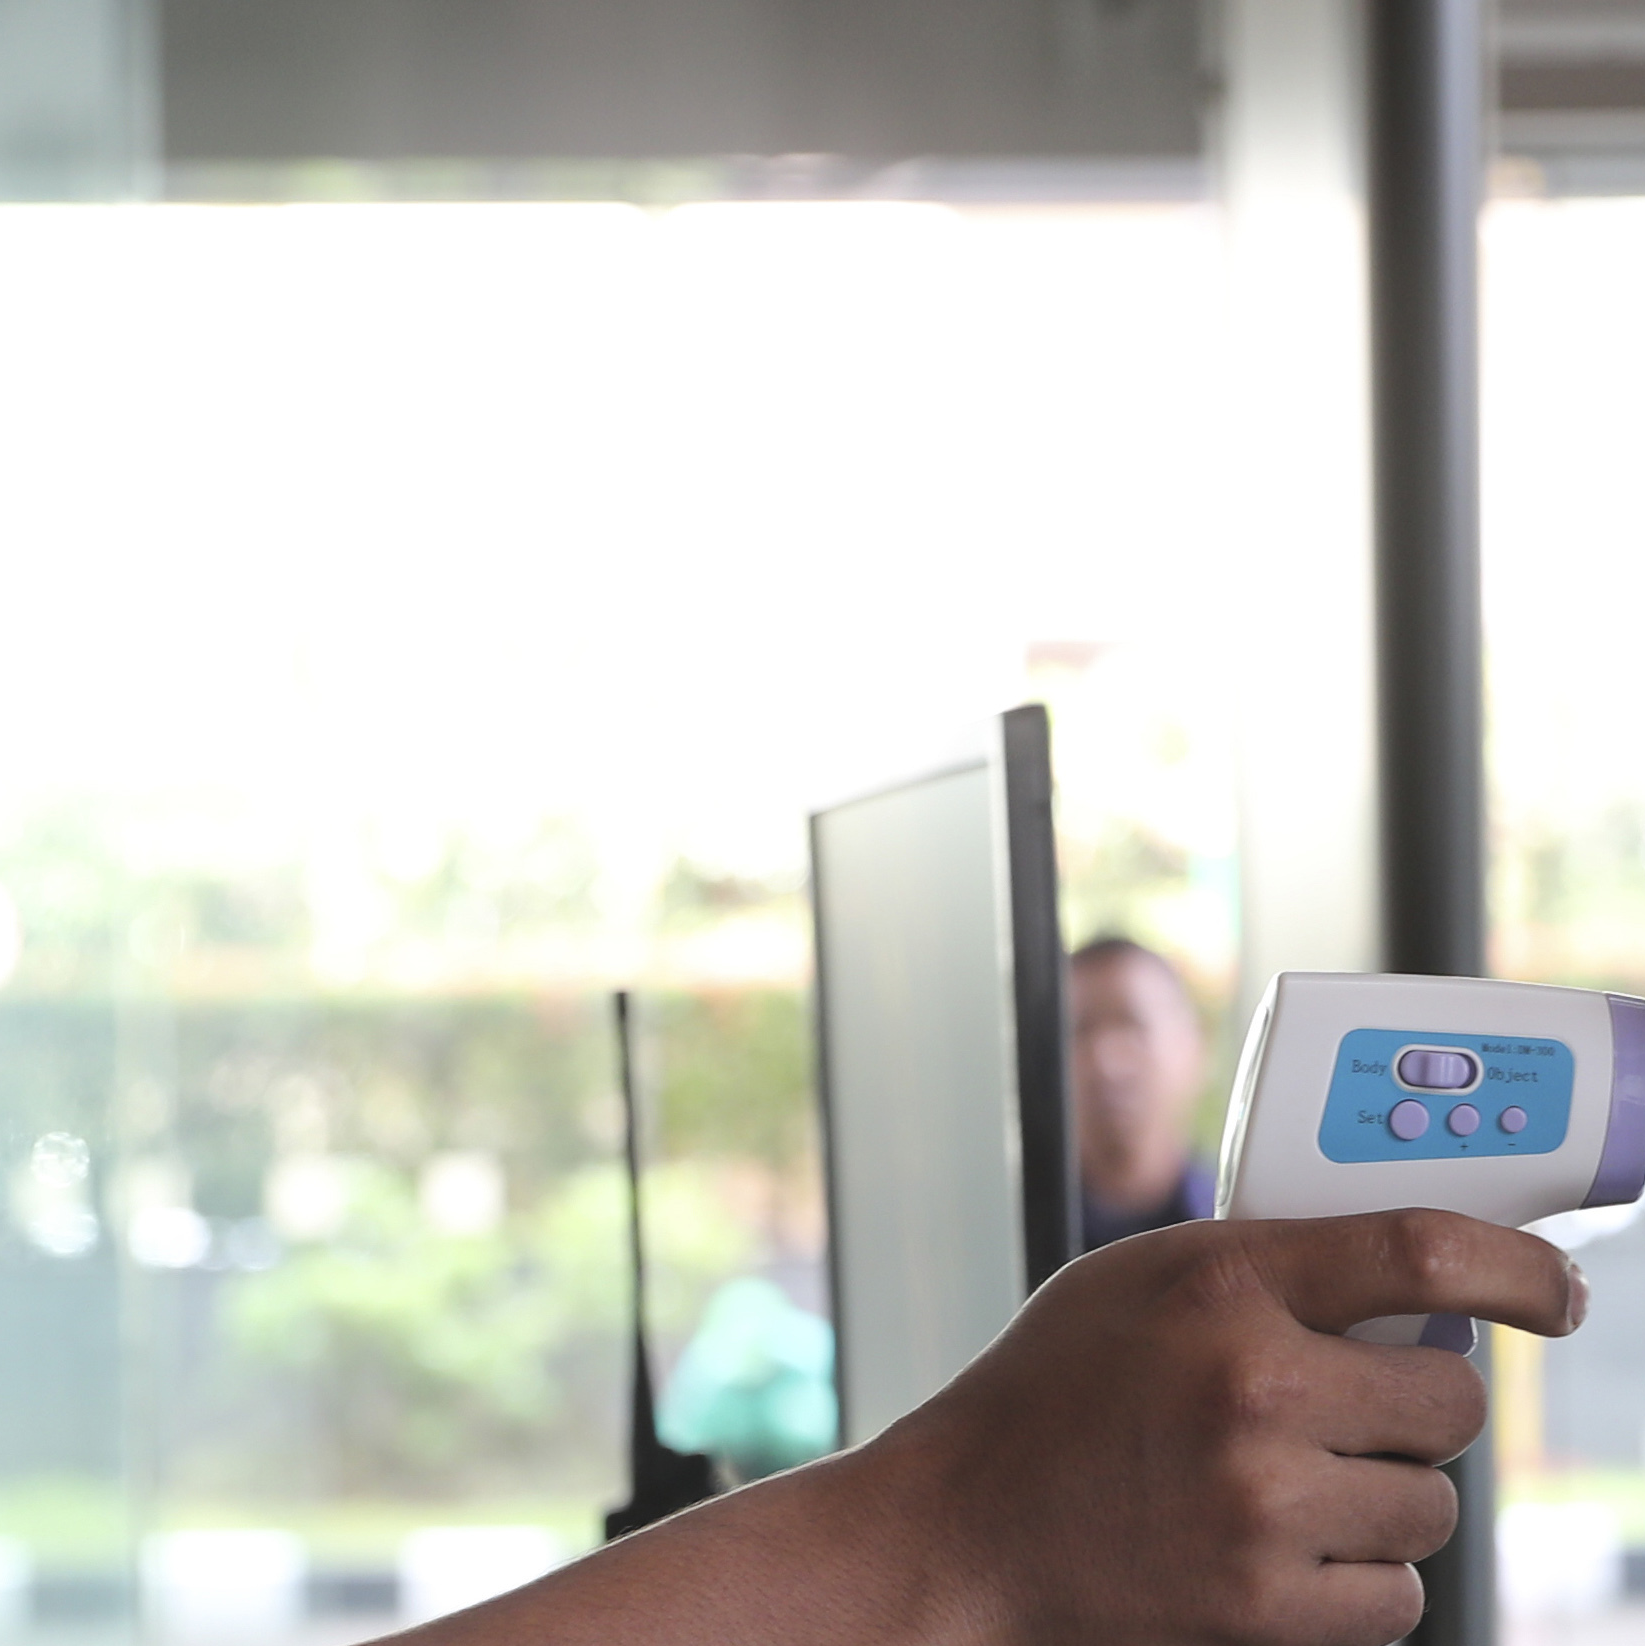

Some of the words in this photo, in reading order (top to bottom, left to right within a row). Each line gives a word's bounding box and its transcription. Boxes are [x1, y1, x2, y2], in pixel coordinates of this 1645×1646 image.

[1351, 1059, 1387, 1076] Body
[1488, 1066, 1539, 1083] Object
[1357, 1110, 1384, 1124] Set
